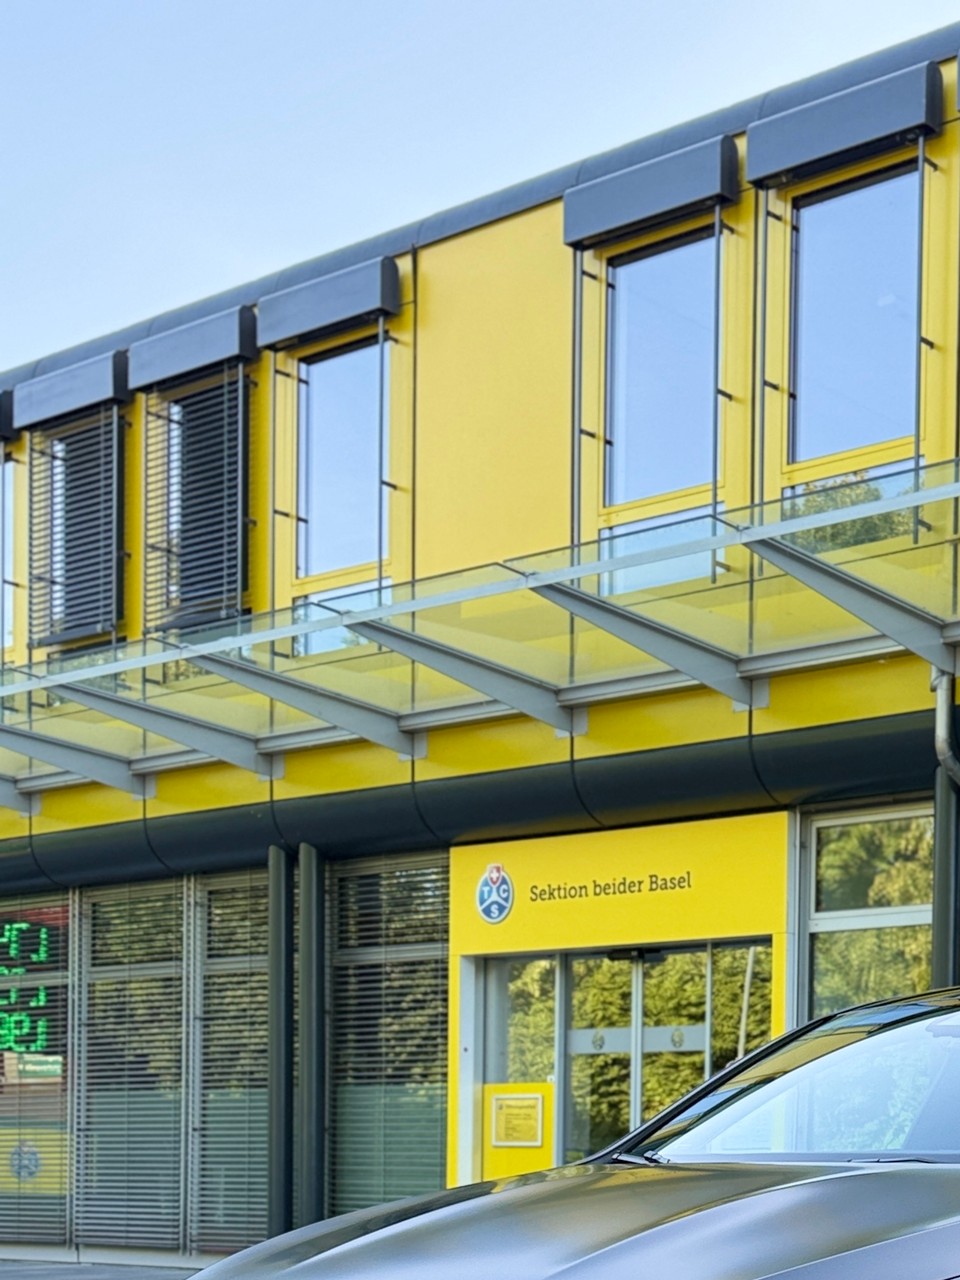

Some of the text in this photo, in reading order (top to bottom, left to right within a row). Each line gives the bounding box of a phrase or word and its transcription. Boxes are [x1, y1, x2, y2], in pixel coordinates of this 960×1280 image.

[529, 871, 692, 902] Sektion beider Basel
